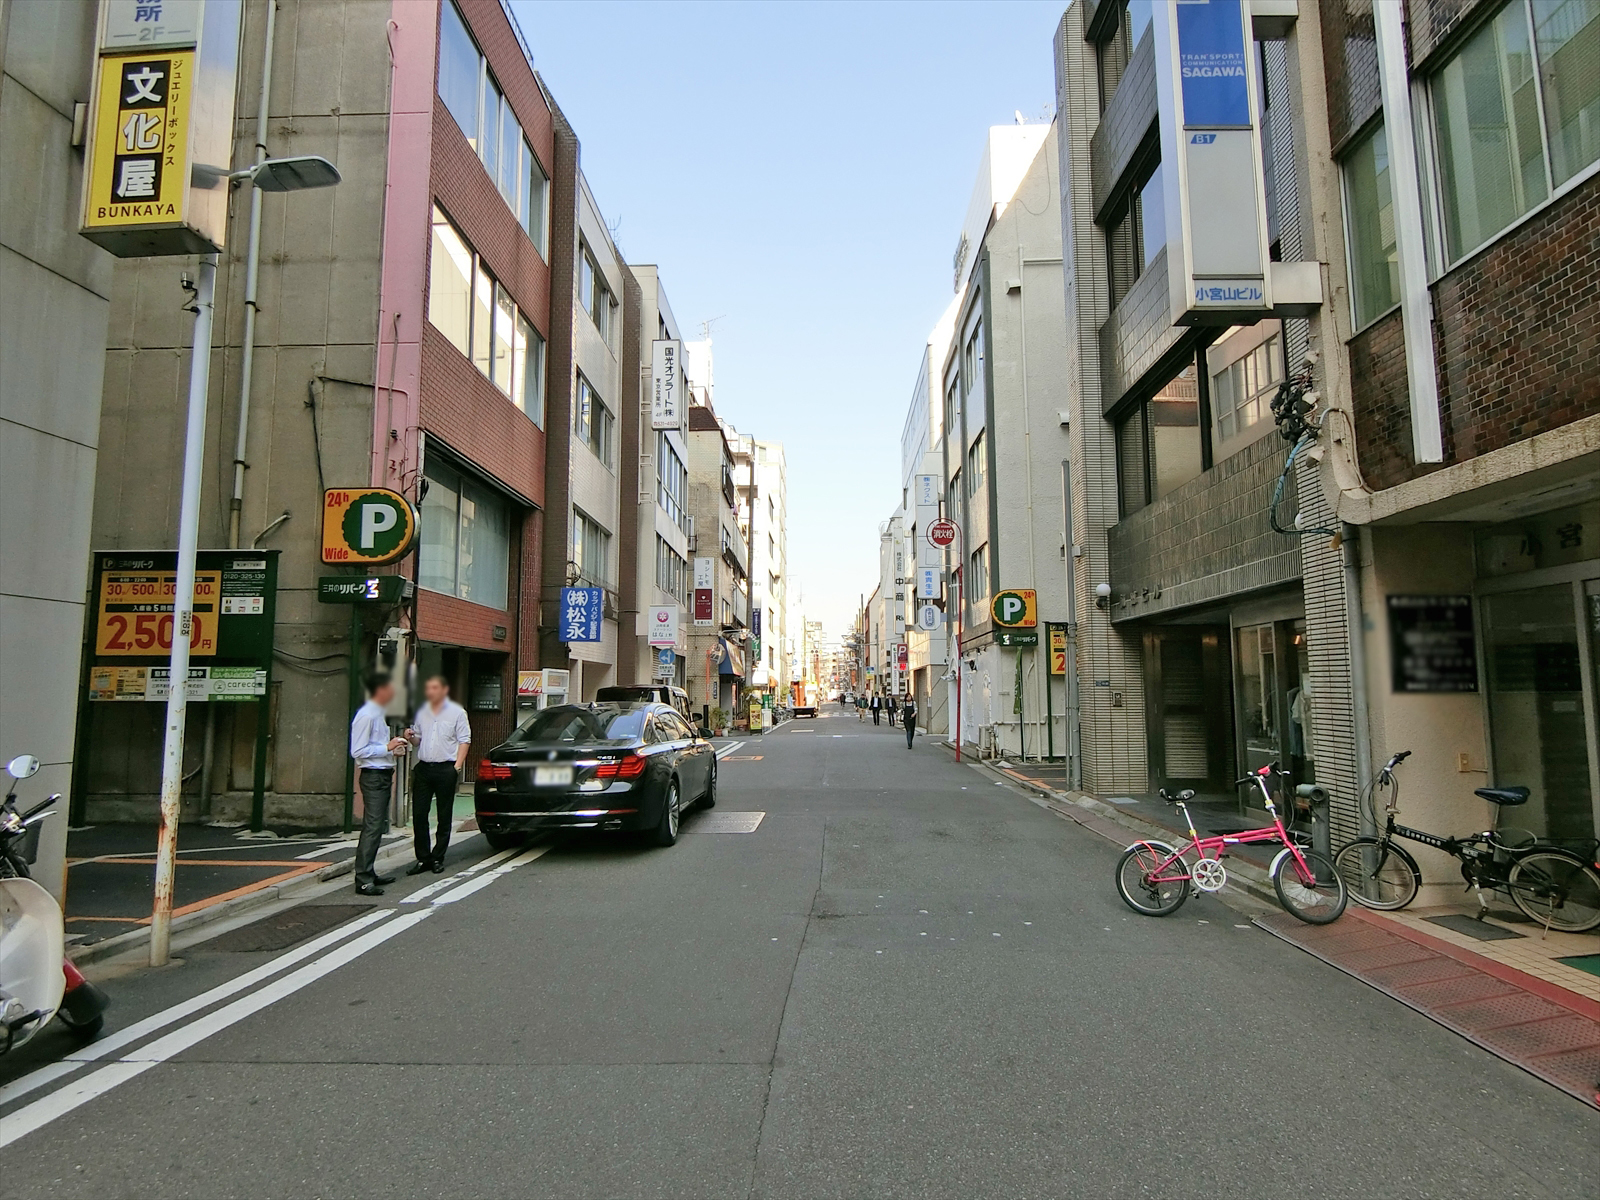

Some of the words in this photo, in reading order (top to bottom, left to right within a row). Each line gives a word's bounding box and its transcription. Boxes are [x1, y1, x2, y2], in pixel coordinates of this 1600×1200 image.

[134, 0, 162, 22] 所
[139, 27, 165, 41] 2F
[1182, 66, 1245, 77] SAGAWA
[164, 59, 183, 166] ジュエリーボックス
[117, 67, 164, 198] 文化屋
[1195, 135, 1211, 144] B1
[97, 203, 175, 219] BUNKAYA
[1195, 287, 1262, 301] 小宮山ビル
[327, 492, 349, 507] 24h
[361, 503, 397, 548] P
[933, 529, 954, 539] 消火栓
[324, 548, 349, 559] Wide
[322, 584, 366, 594] 三井のリパーク
[132, 604, 175, 612] 入庫後5時間
[1003, 597, 1021, 621] P
[898, 646, 907, 657] P
